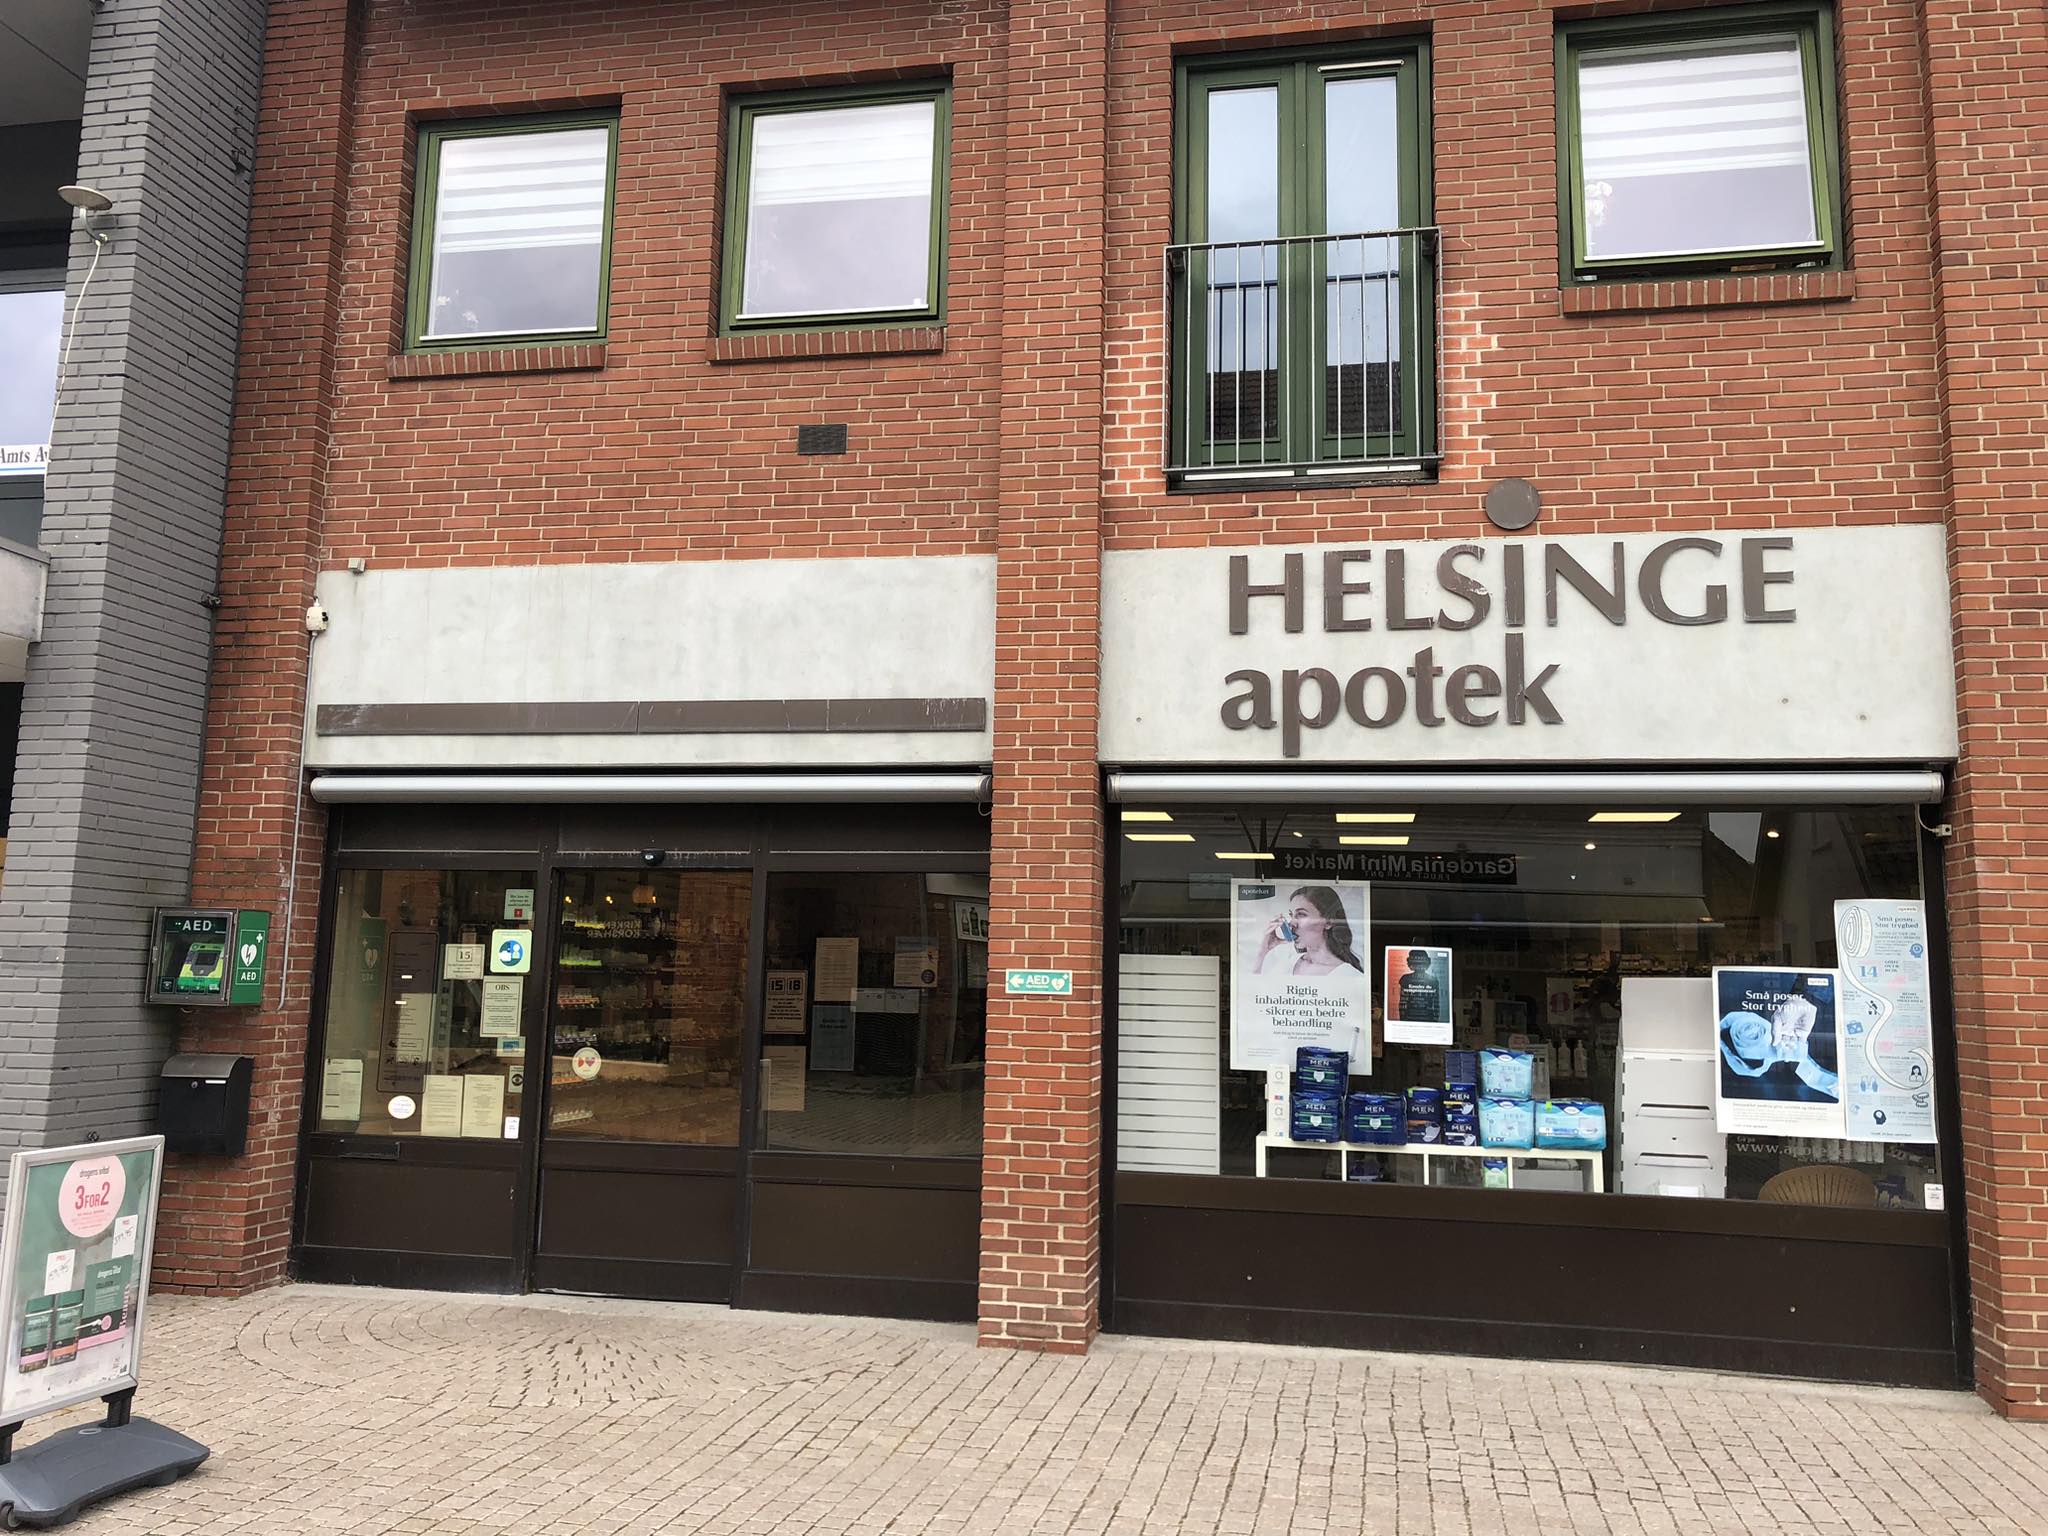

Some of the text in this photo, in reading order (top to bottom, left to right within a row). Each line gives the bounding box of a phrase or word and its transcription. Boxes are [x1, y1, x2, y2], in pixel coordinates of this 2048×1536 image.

[1229, 537, 1796, 635] HELSINGE
[1220, 632, 1563, 757] apotek
[182, 920, 212, 931] AED
[459, 951, 471, 959] 15
[241, 972, 257, 981] AED
[1026, 975, 1050, 985] AED
[770, 979, 783, 990] 15
[1287, 985, 1318, 997] Rigtig
[1745, 990, 1770, 1000] Små
[1255, 995, 1349, 1008] inhalationsteknik
[1741, 1001, 1764, 1011] Stor
[1265, 1006, 1296, 1016] sikrer
[1299, 1009, 1313, 1017] en
[1316, 1008, 1345, 1018] bedre
[1272, 1016, 1332, 1030] behandling
[1451, 1124, 1472, 1132] MEN
